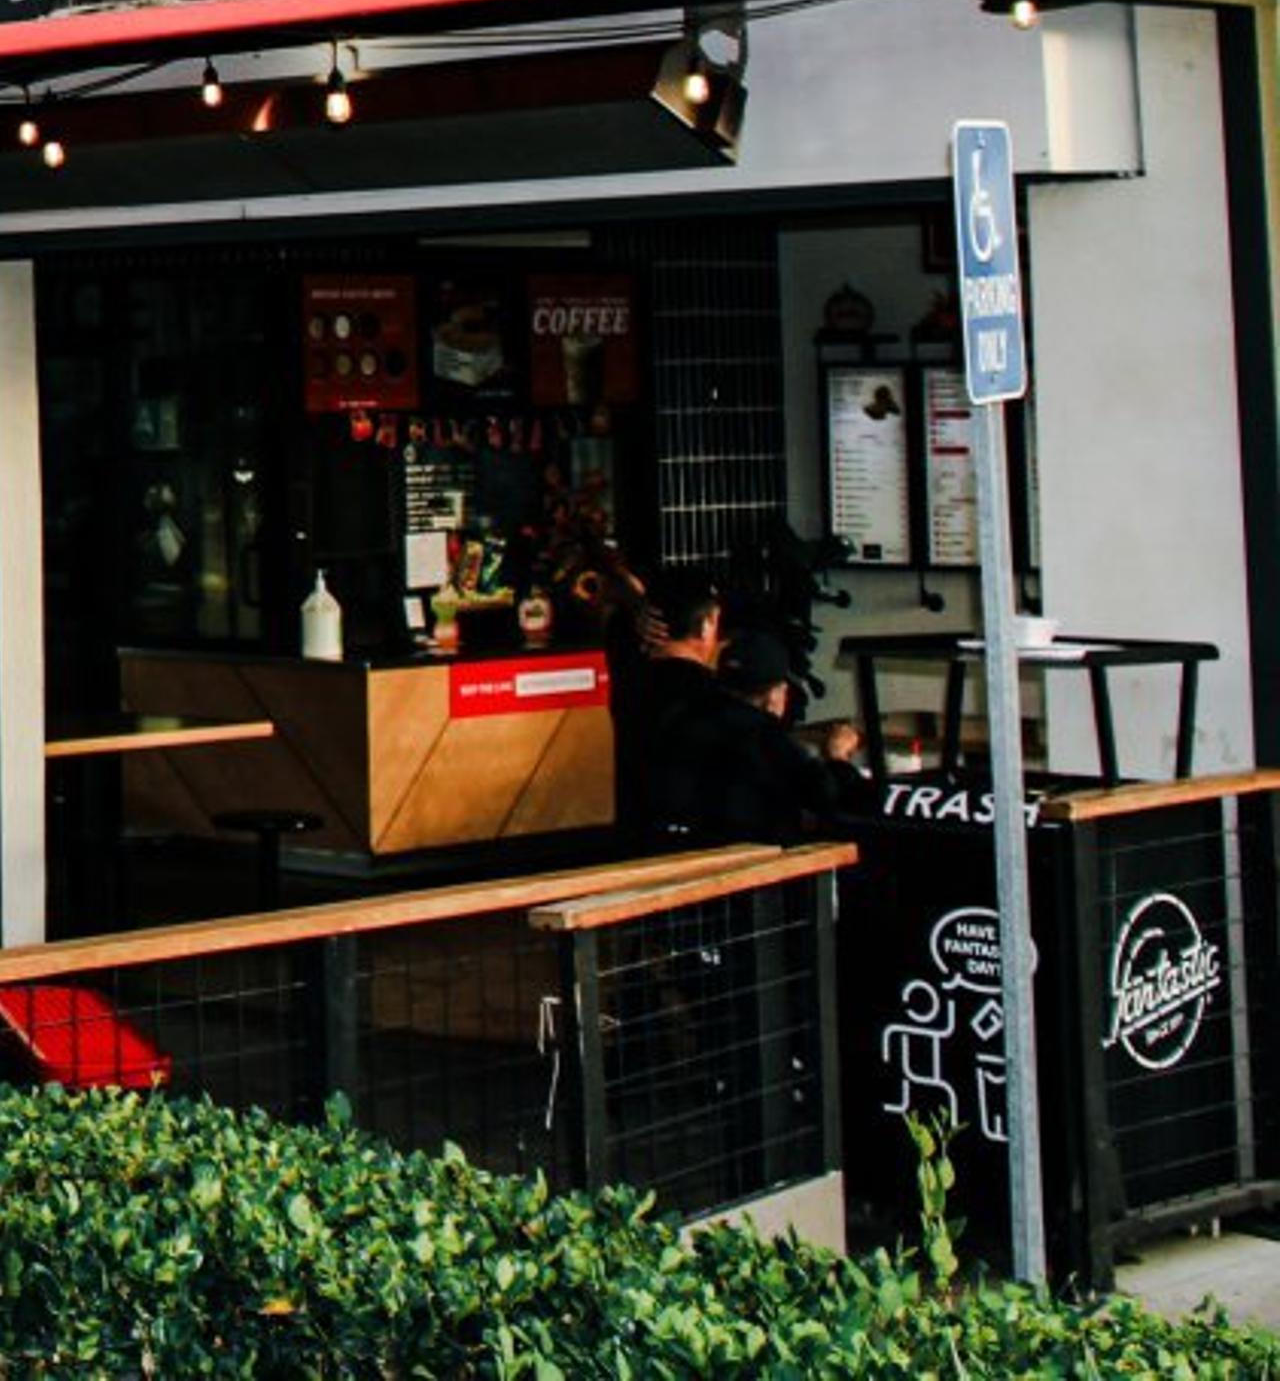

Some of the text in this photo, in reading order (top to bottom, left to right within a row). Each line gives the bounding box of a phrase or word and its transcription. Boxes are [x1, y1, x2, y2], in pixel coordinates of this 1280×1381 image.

[532, 306, 630, 335] COFFEE
[956, 921, 996, 941] HAVE
[944, 938, 1002, 959] FANTAS
